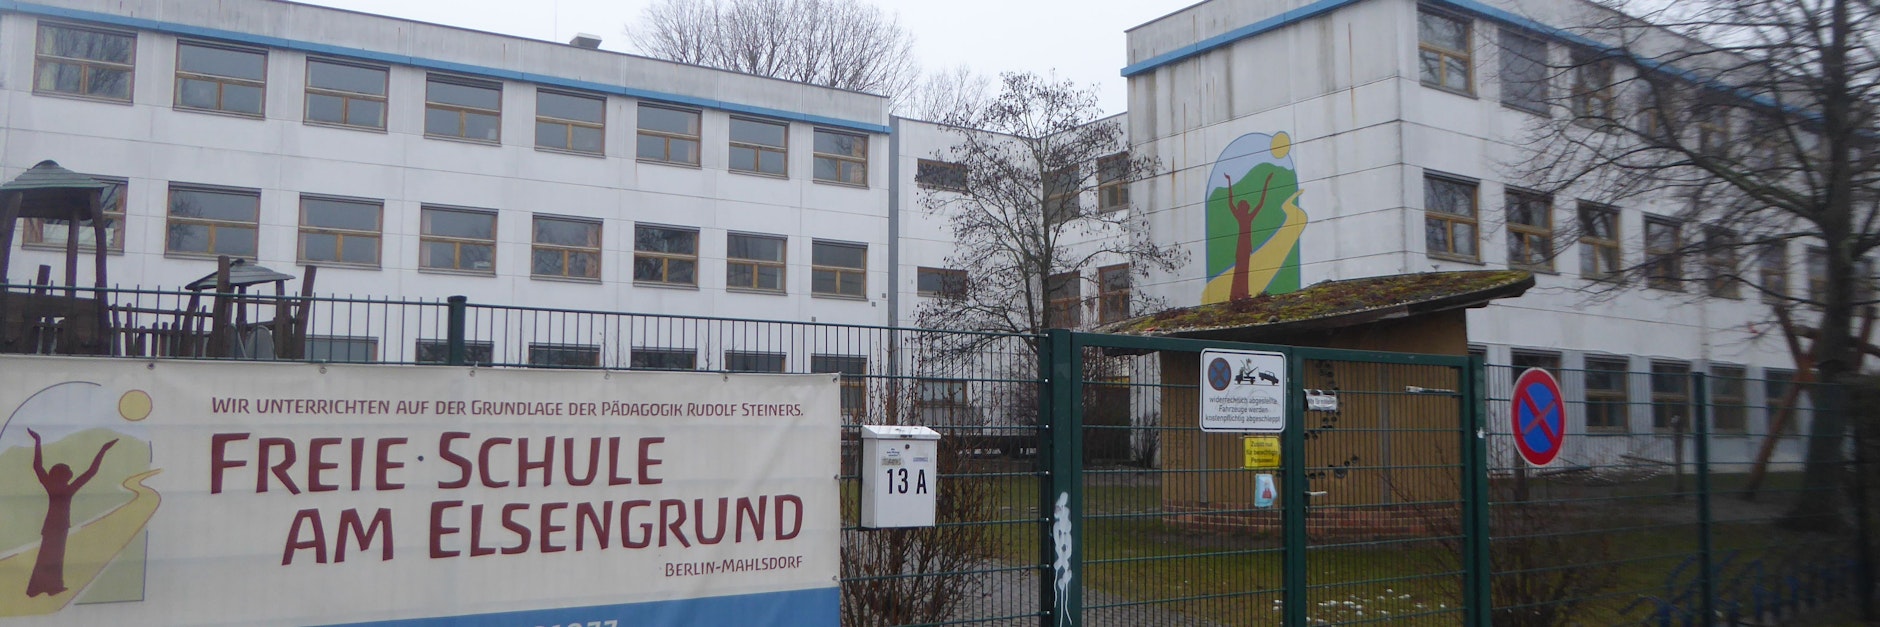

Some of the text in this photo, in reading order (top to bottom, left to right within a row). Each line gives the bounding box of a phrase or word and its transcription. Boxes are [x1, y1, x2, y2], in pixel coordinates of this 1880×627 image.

[211, 397, 804, 417] WIR UNTERRICHTEN AUF DER GRUNDLAGE DER PÄDAGOGIK RUDOLF STEINERS.
[211, 431, 665, 495] FREIE SCHULE
[886, 468, 927, 494] 13 A
[281, 494, 804, 566] AM ELSENGRUND
[665, 555, 803, 577] BERLIN-MAHLSDORF
